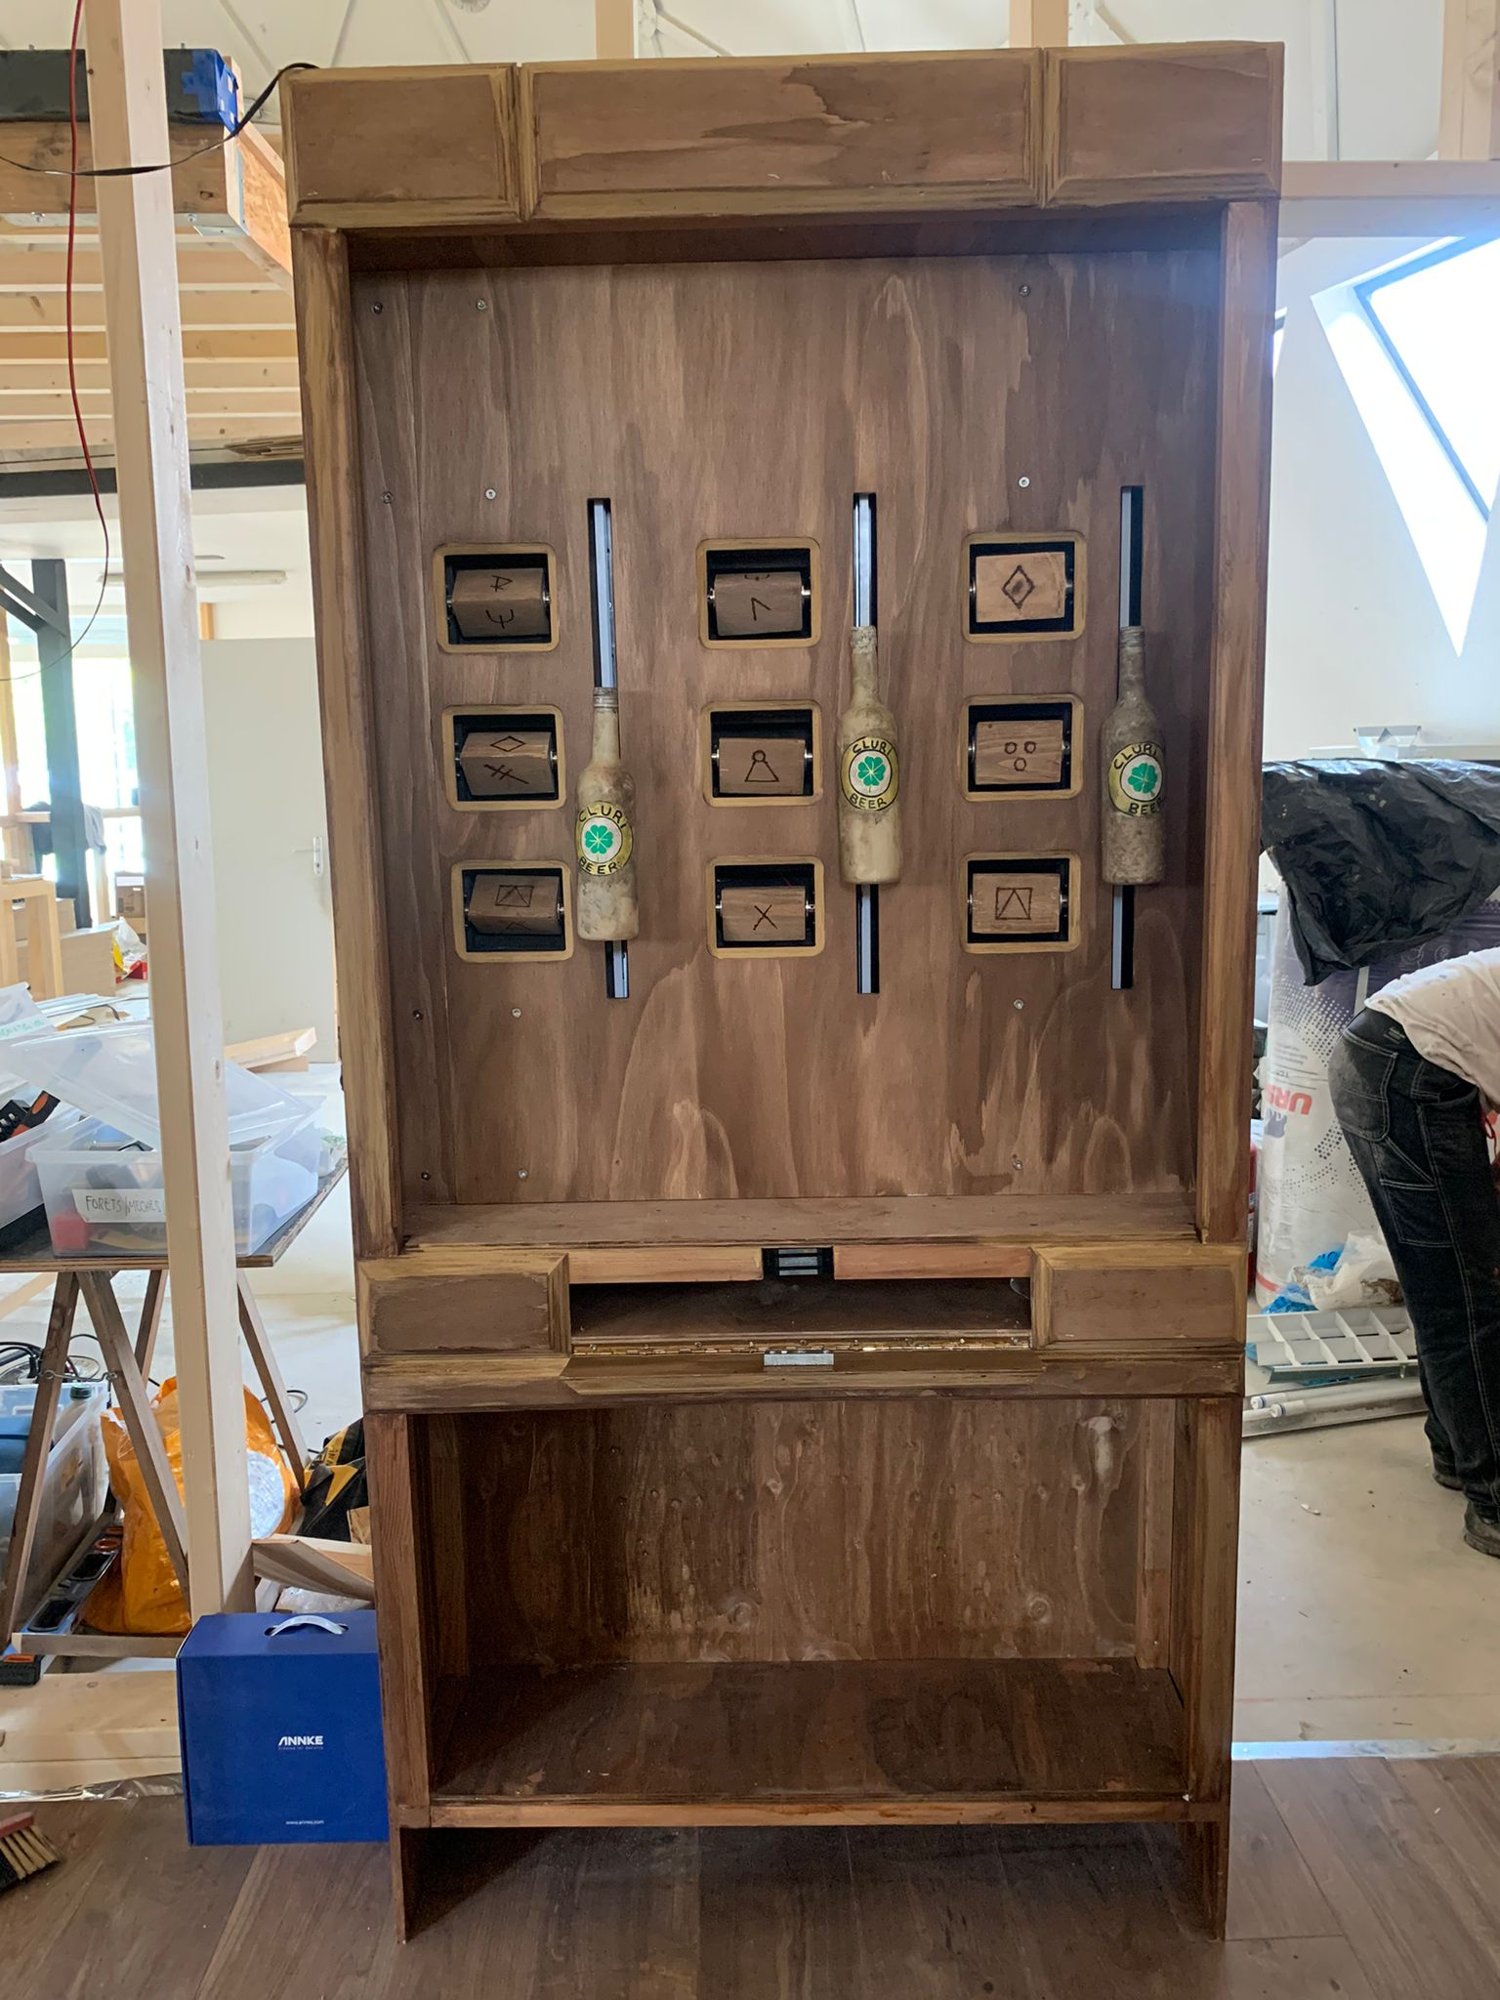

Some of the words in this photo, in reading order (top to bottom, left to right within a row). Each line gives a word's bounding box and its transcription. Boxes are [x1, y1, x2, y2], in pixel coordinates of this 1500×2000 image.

[852, 740, 893, 755] CLURI
[1113, 743, 1157, 770] CLURI
[849, 793, 887, 809] BEER
[579, 805, 627, 829] CLURI
[579, 856, 618, 875] BEER
[1265, 1085, 1312, 1115] URS
[278, 1735, 324, 1746] ANNKE
